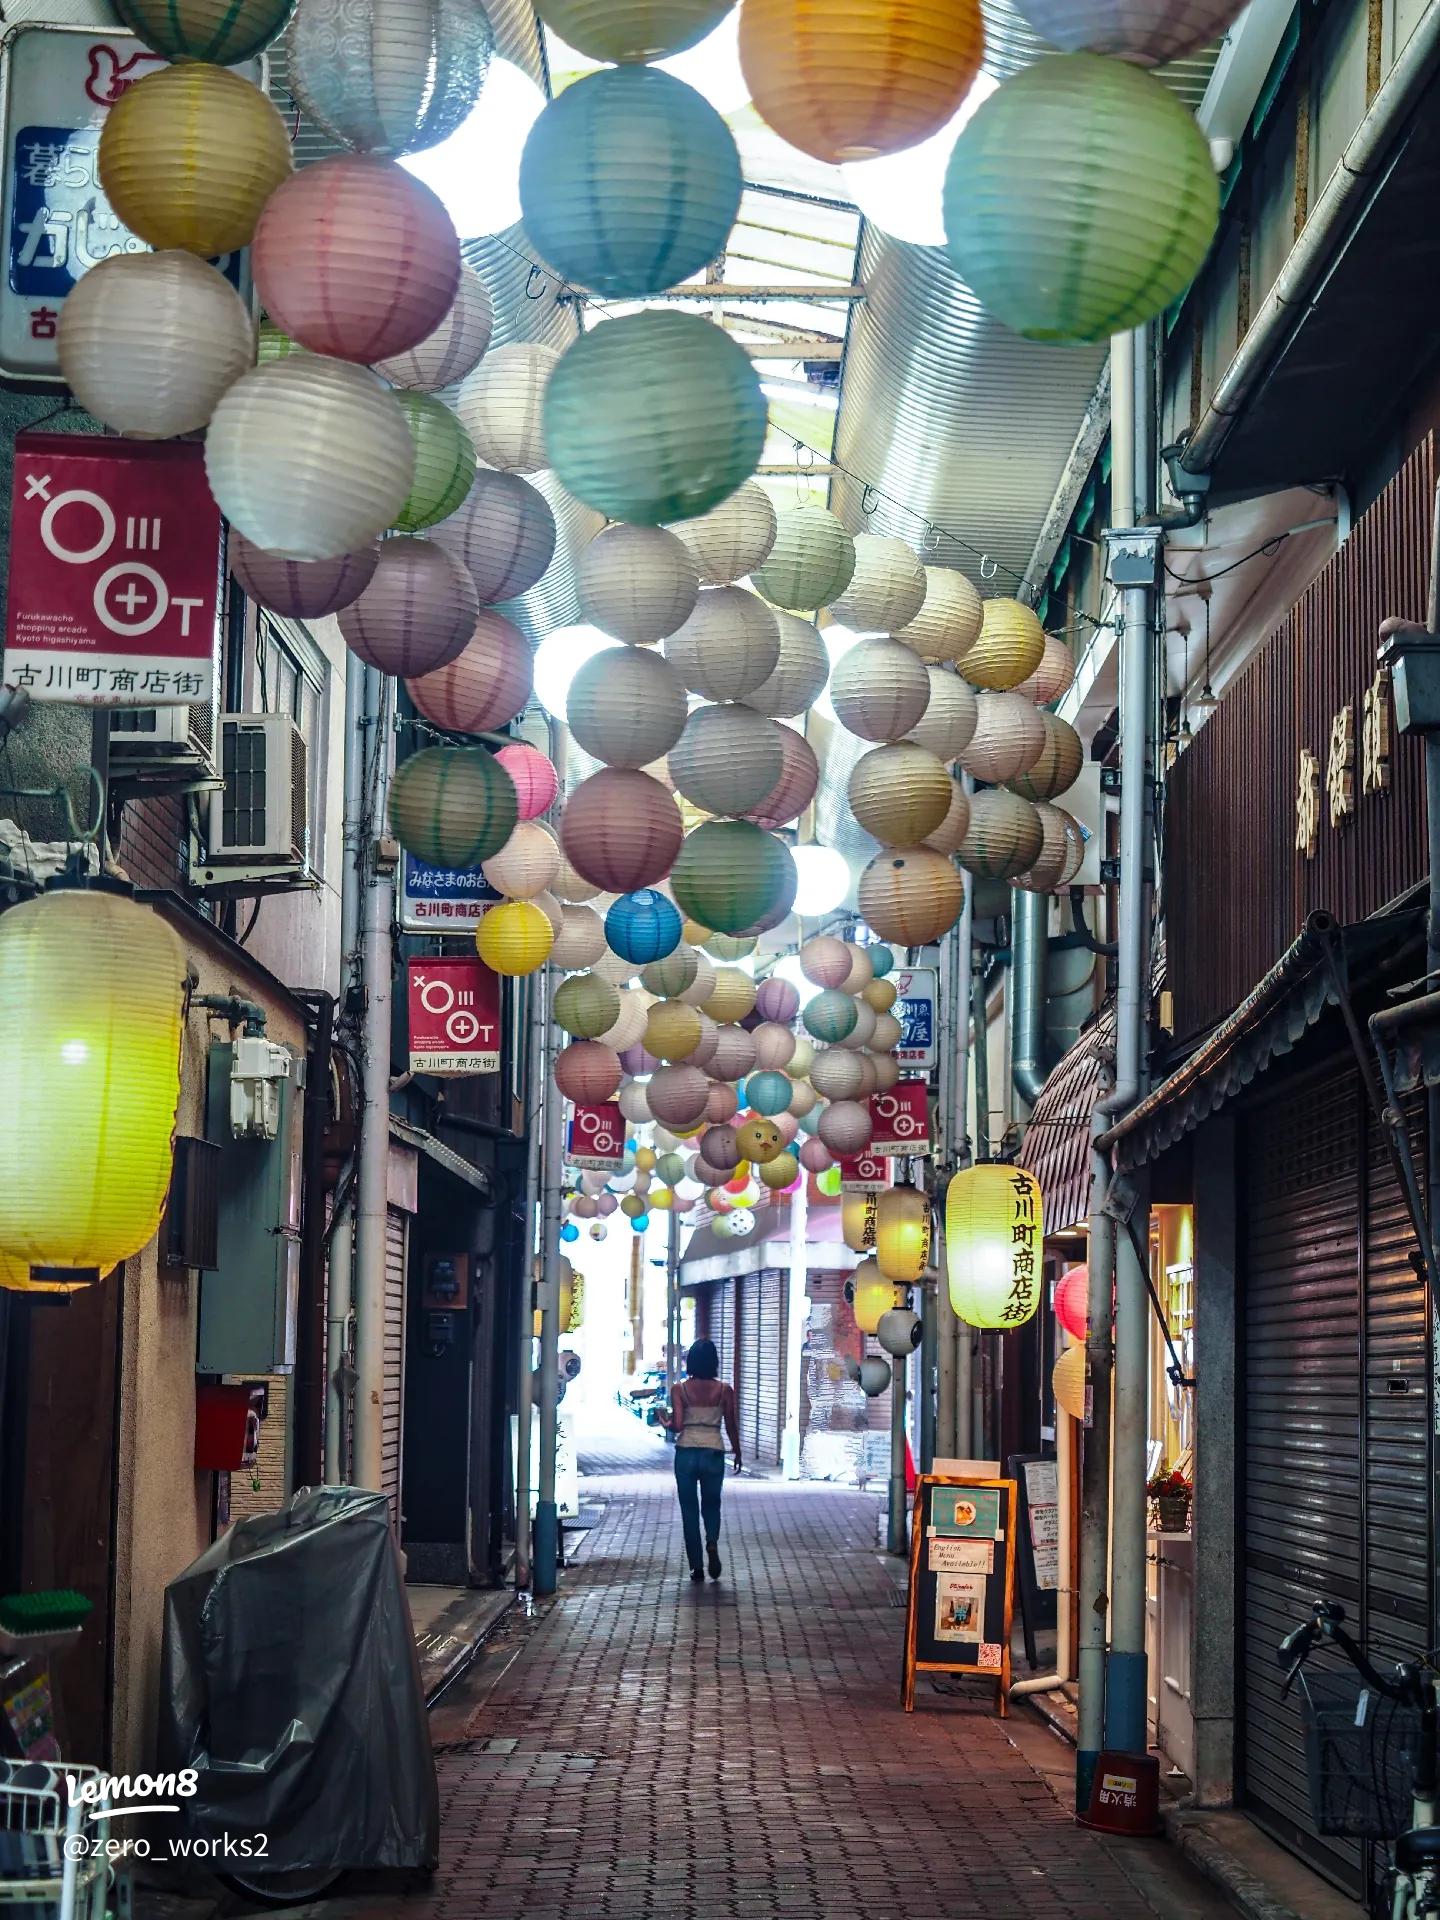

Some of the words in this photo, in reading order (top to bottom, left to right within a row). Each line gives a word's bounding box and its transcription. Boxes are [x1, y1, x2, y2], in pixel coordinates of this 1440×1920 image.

[16, 612, 74, 622] Furukawacho
[16, 624, 56, 633] shopping
[58, 626, 88, 634] arcade
[16, 634, 41, 643] Kyoto
[42, 635, 97, 645] higashiyama
[12, 663, 205, 695] 古川町商店街
[409, 871, 490, 888] みなさまのお台
[413, 1057, 497, 1069] 古川町商店街
[918, 1202, 932, 1271] 古川町商店街
[998, 1173, 1037, 1322] 古川町商店街
[1099, 1789, 1137, 1808] 消火用
